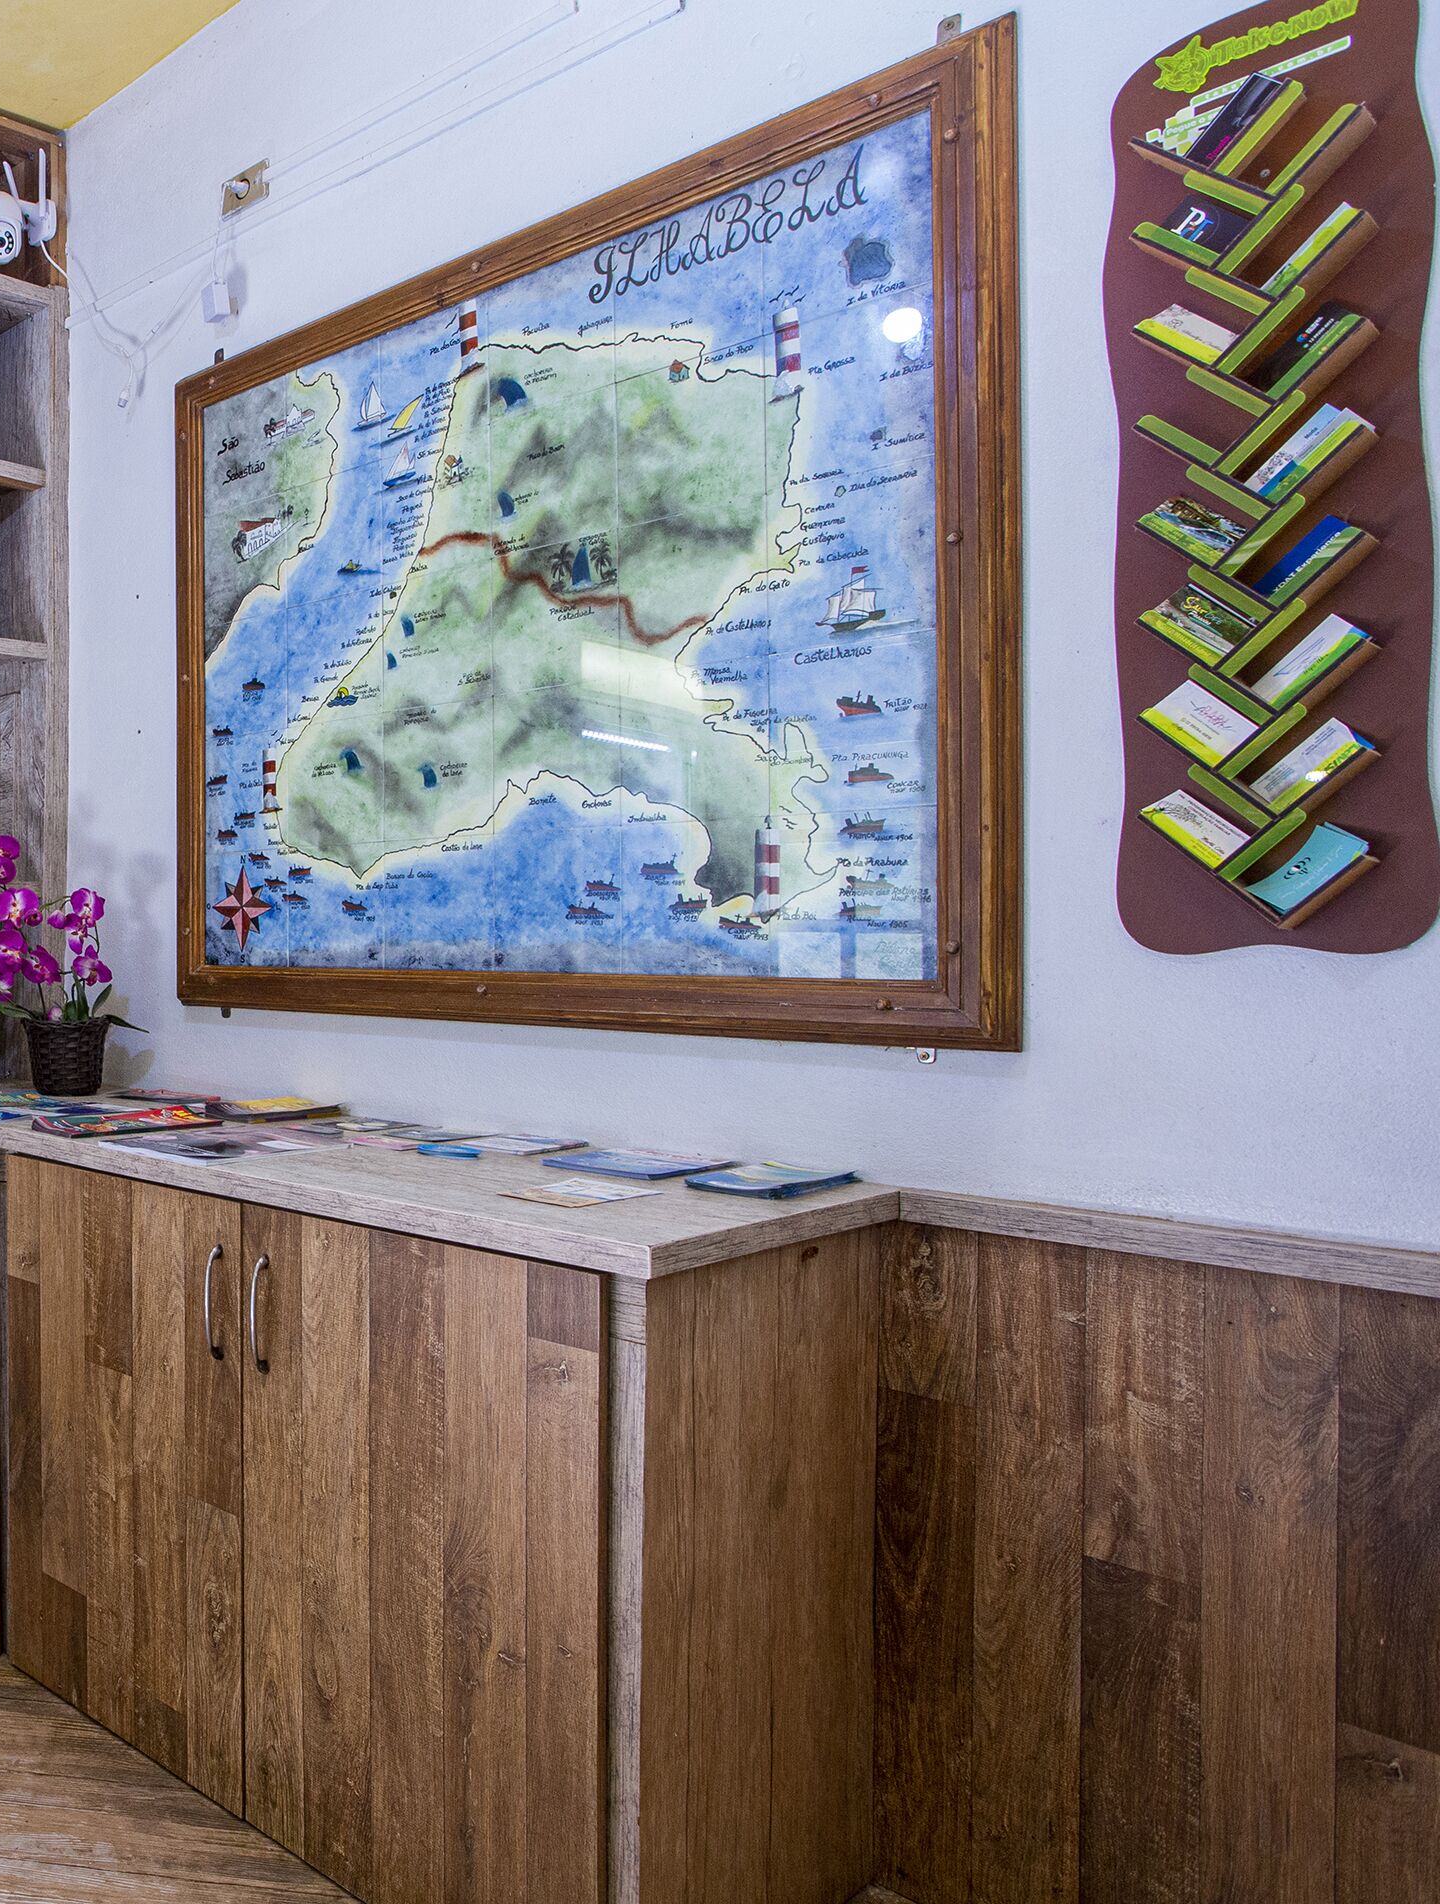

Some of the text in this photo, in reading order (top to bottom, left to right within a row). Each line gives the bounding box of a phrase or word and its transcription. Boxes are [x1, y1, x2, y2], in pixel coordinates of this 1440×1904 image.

[588, 143, 869, 304] ILHABELA
[670, 317, 694, 330] Fome
[704, 352, 724, 365] Saco
[725, 347, 735, 358] do
[217, 436, 240, 456] São
[222, 460, 266, 486] Sebastião
[416, 474, 434, 485] Vila
[801, 531, 846, 550] Eustáquio
[826, 546, 870, 563] Cabeçuda
[1296, 531, 1341, 572] Experience
[755, 580, 766, 593] do
[767, 579, 791, 592] Gato
[793, 645, 873, 666] Castelhanos
[528, 796, 558, 807] Bonete
[239, 856, 246, 864] N
[802, 910, 817, 920] Boi
[240, 953, 246, 963] S
